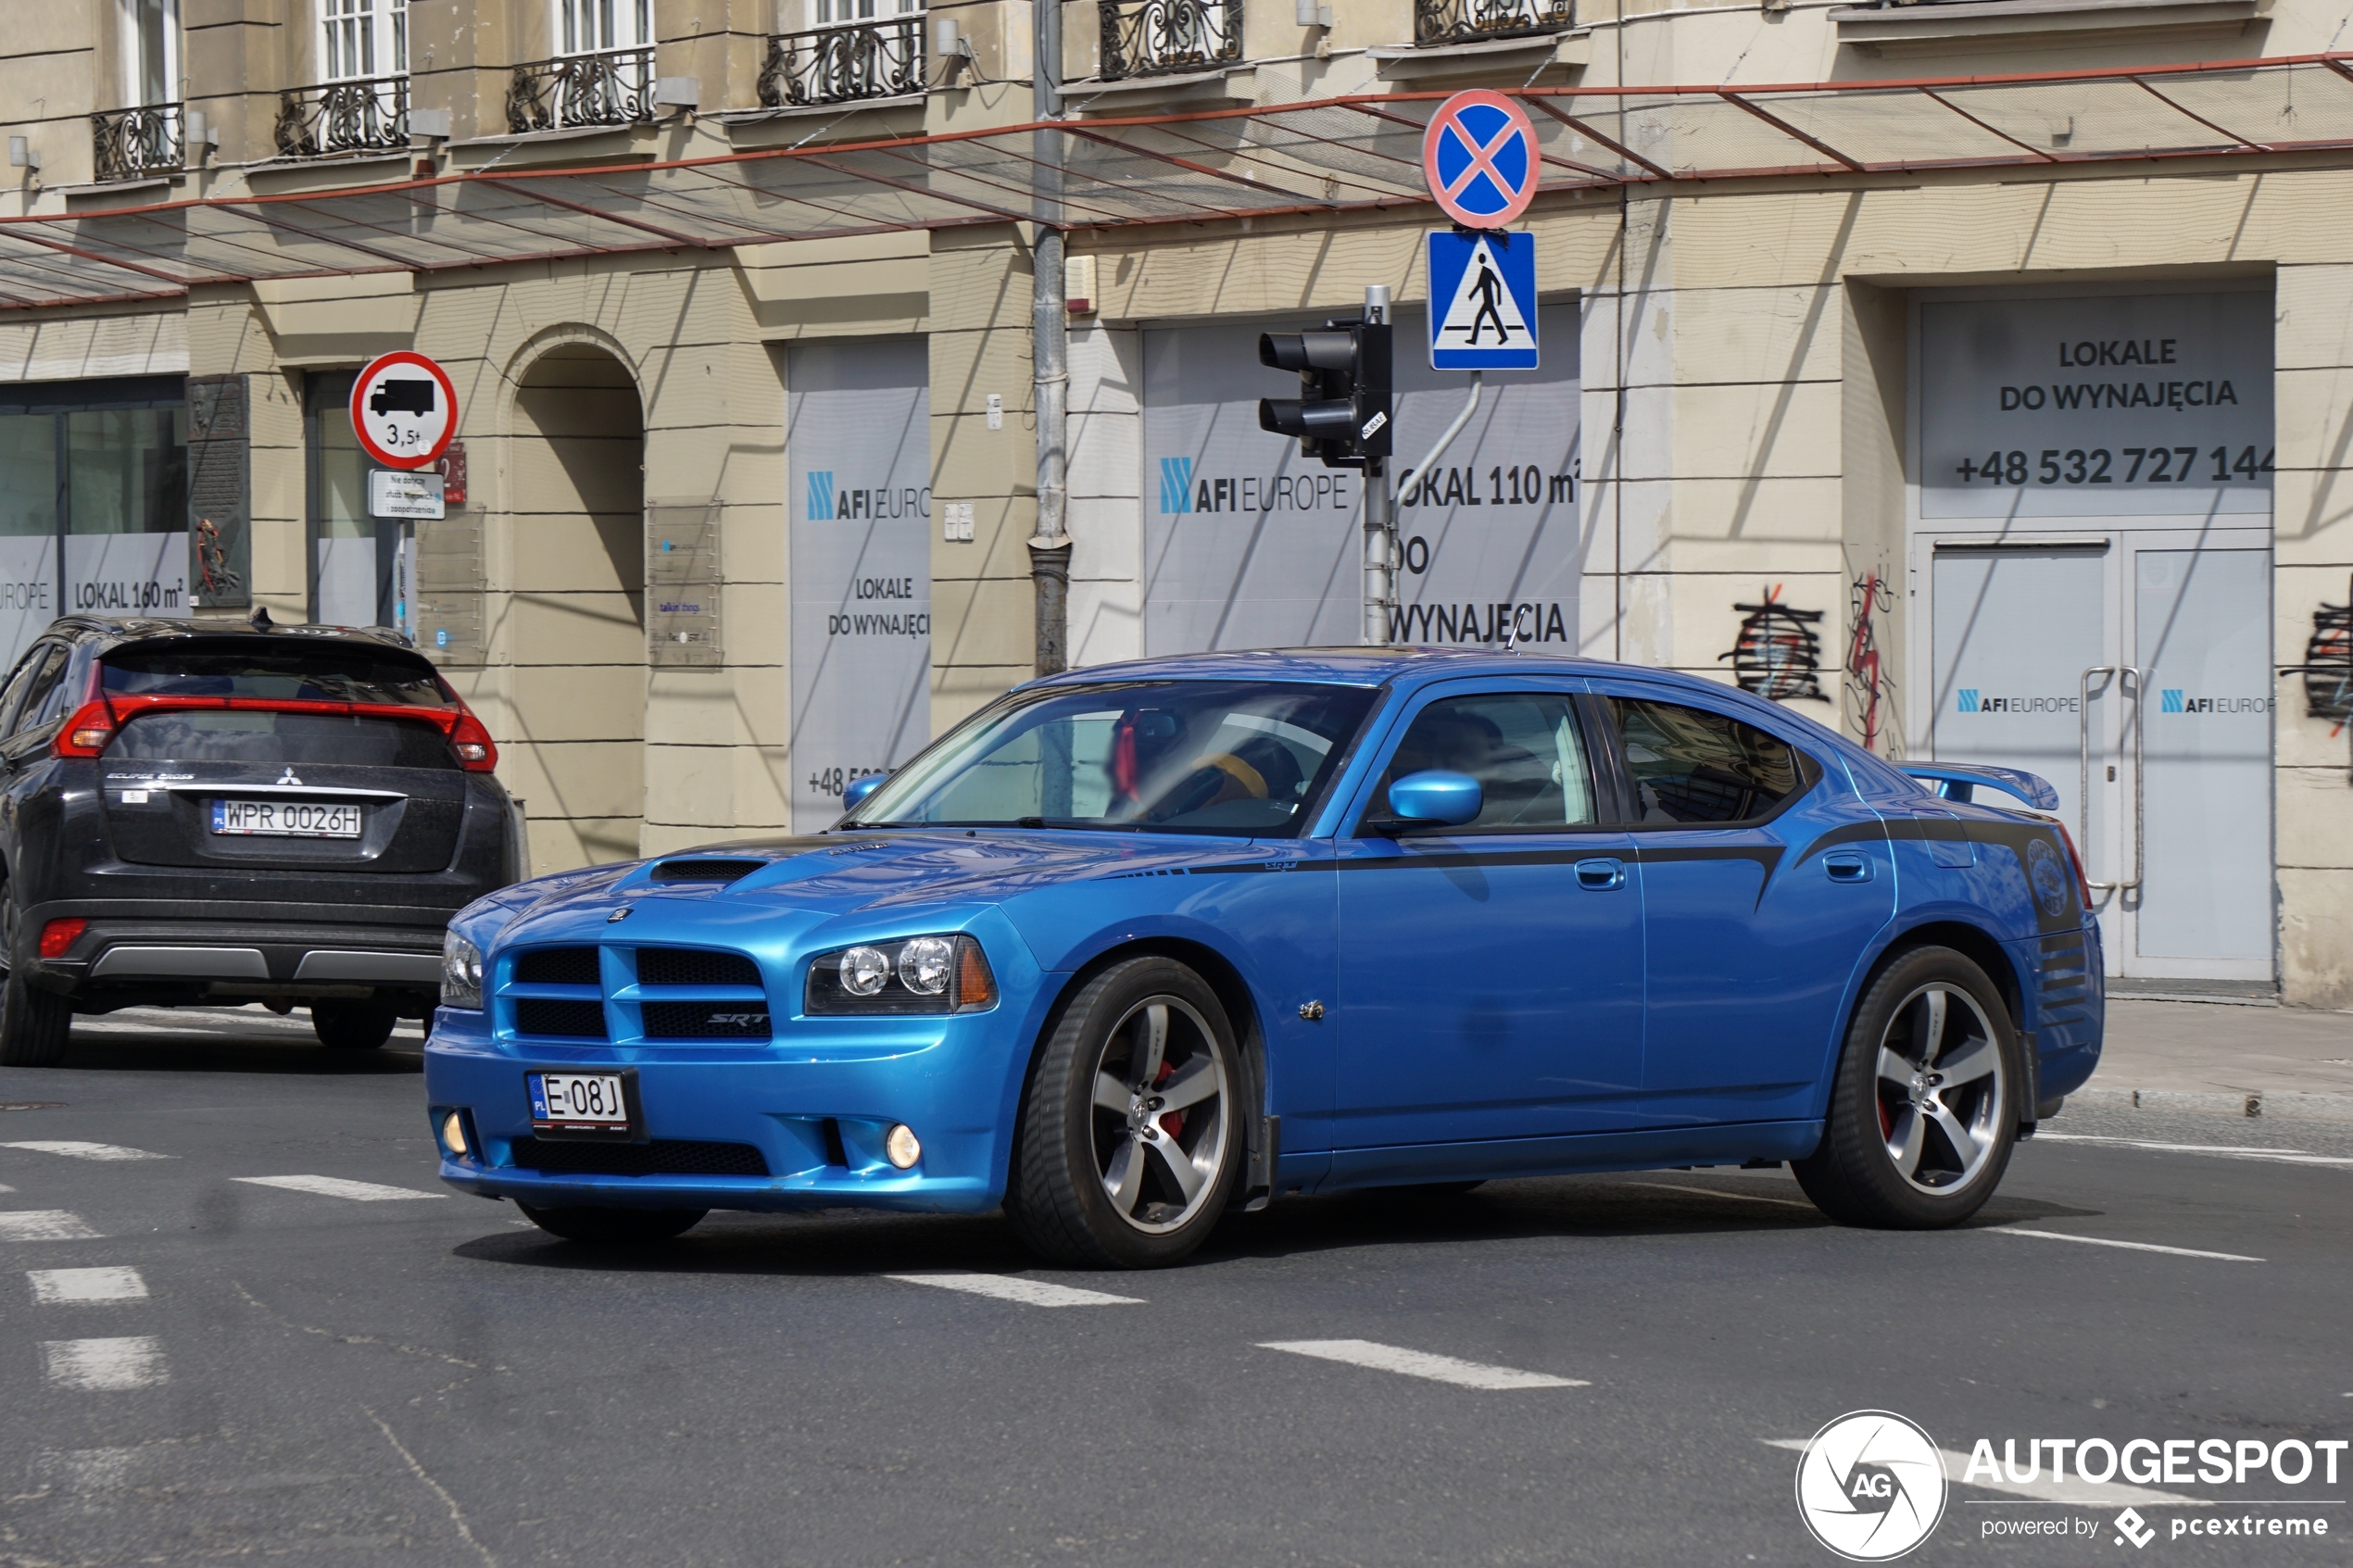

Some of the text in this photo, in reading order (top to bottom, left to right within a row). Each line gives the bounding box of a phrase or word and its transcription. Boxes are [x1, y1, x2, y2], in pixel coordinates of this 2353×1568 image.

[2059, 339, 2177, 368] LOKALE
[2000, 381, 2238, 412] DO WYNAJĘCIA
[1957, 450, 2028, 485] +48
[2038, 449, 2113, 484] 532
[2122, 446, 2198, 483] 727
[390, 475, 402, 483] Nie
[1390, 467, 1481, 508] OKAL
[1490, 465, 1541, 505] 110
[837, 489, 871, 520] AFI
[1195, 474, 1347, 512] AFI EUROPE
[75, 583, 128, 608] LOKAL
[133, 582, 160, 608] 160
[856, 578, 912, 599] LOKALE
[828, 614, 850, 635] DO
[1981, 697, 2079, 713] AFI EUROPE
[2185, 698, 2213, 713] AFI
[809, 768, 843, 797] +48
[214, 817, 224, 825] PL
[228, 803, 358, 832] WPR 0026H
[1266, 861, 1296, 872] SRT
[708, 1013, 770, 1027] SRT
[535, 1100, 546, 1111] PL
